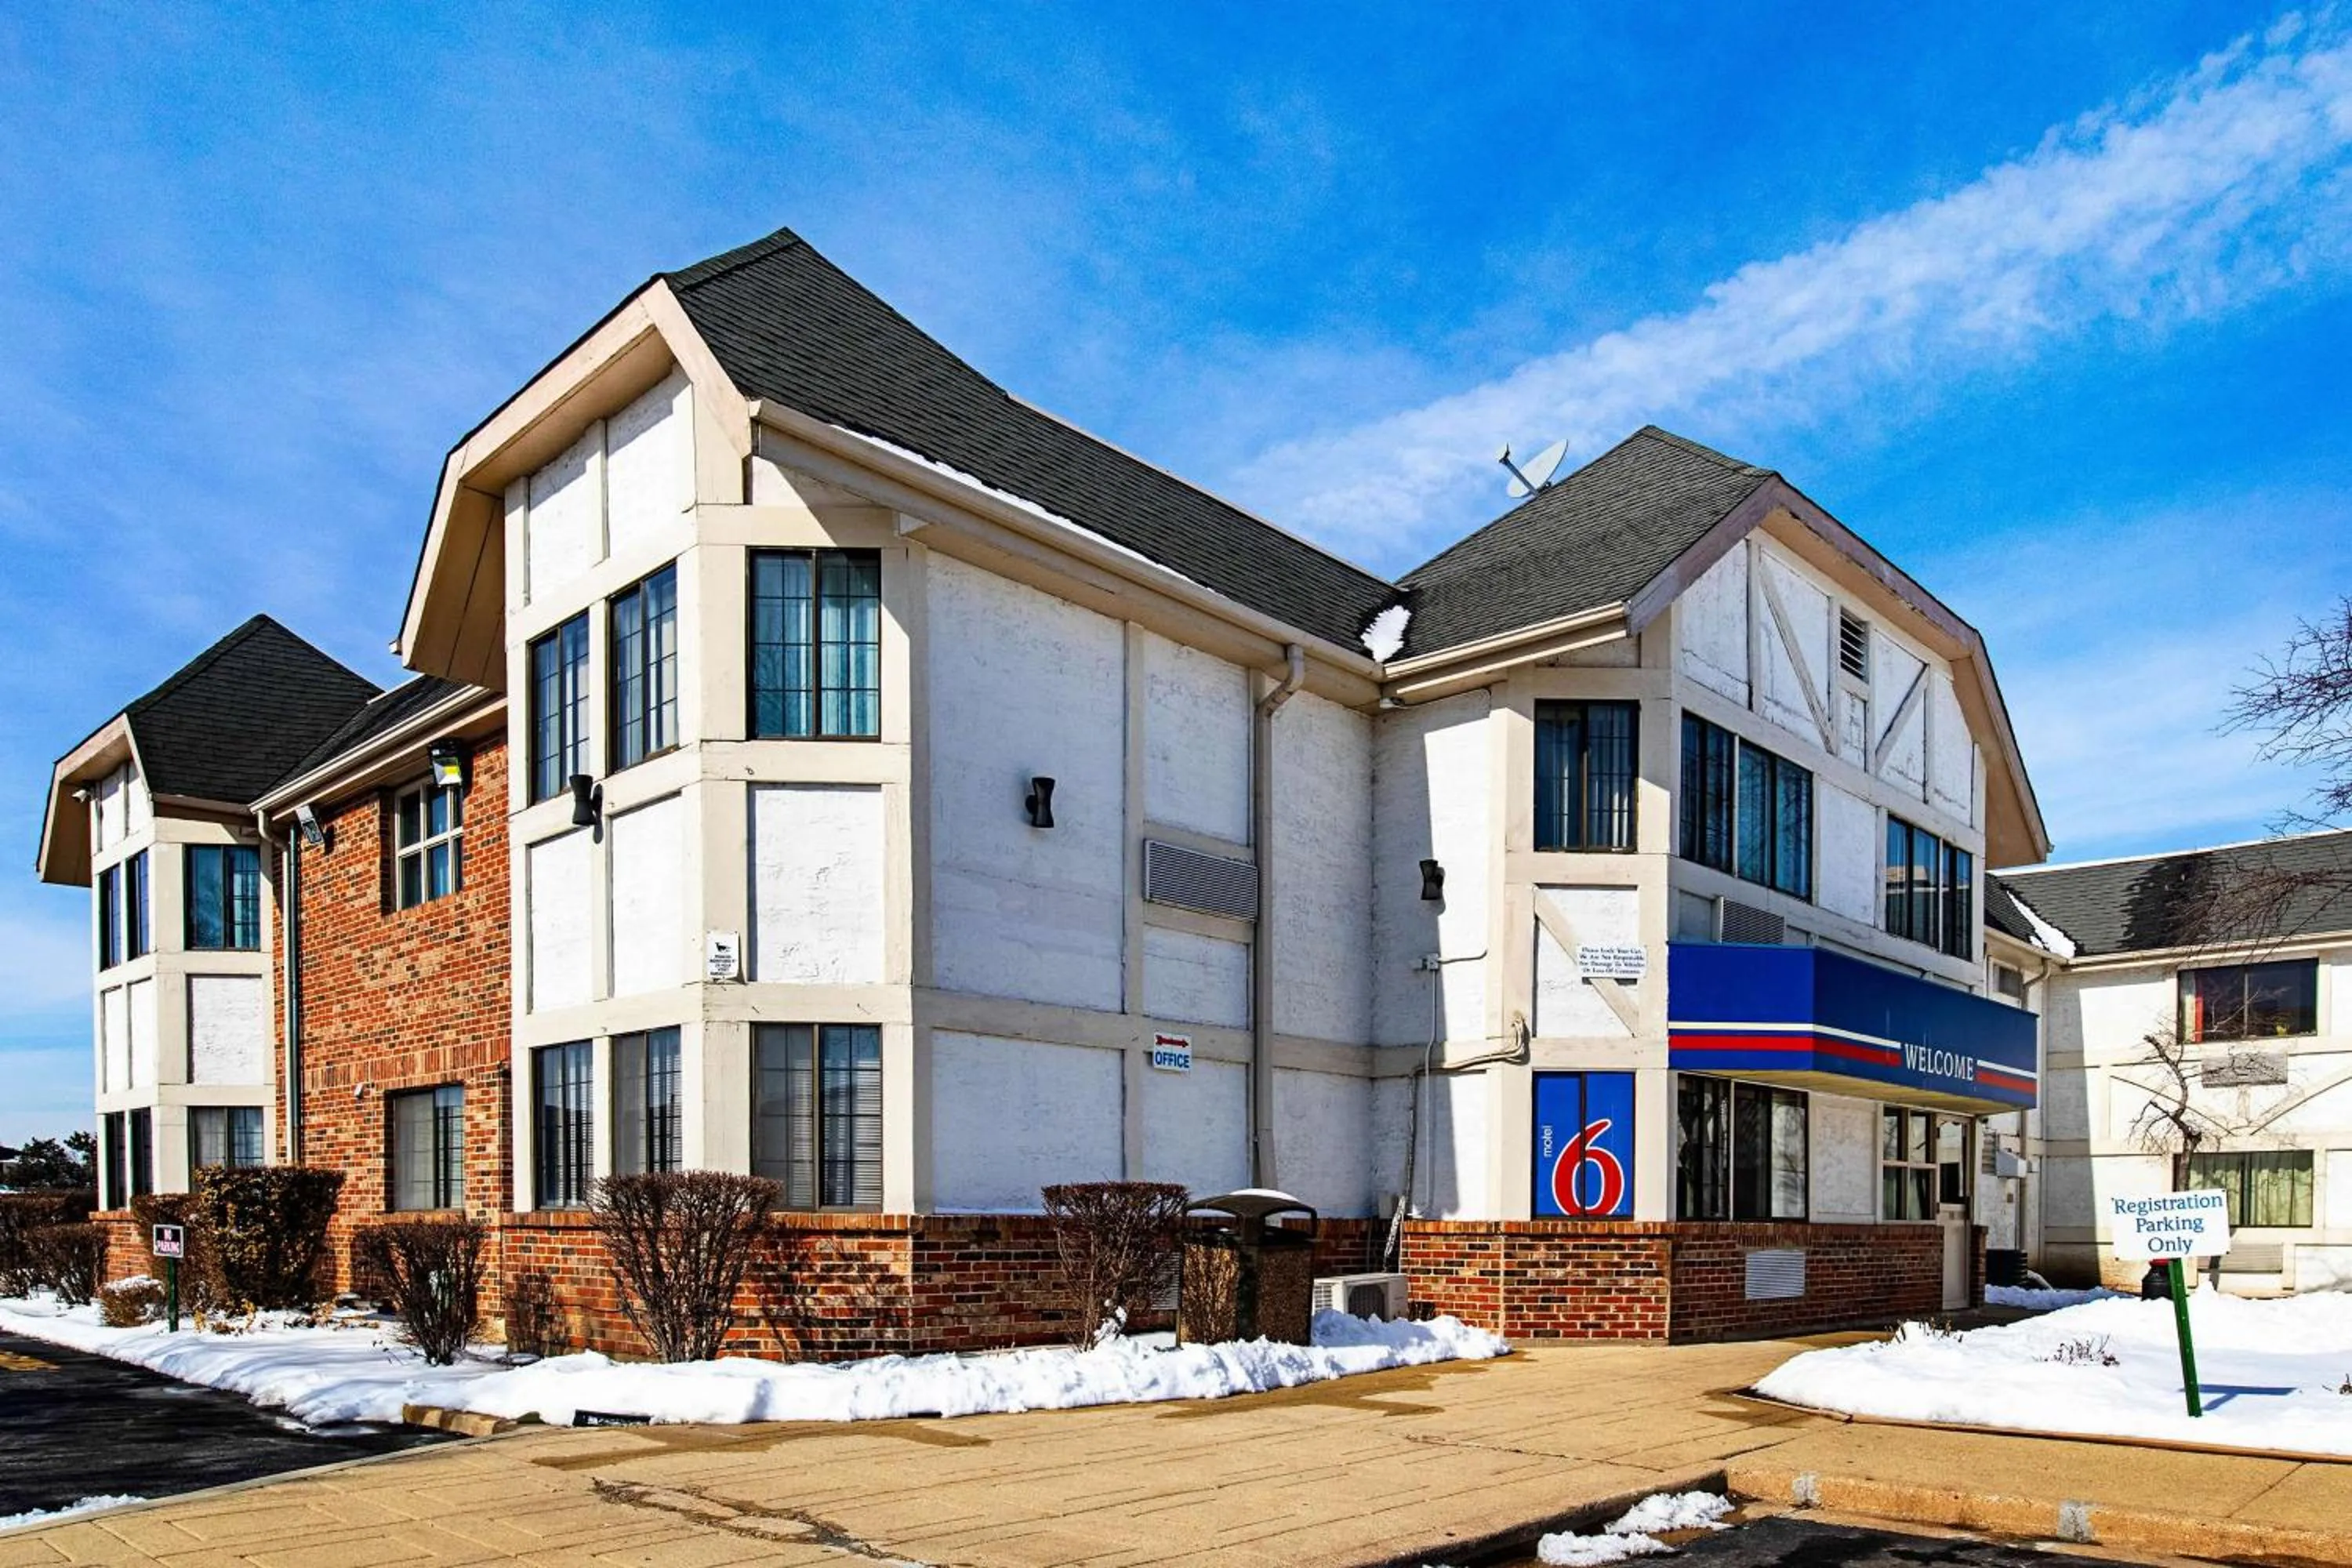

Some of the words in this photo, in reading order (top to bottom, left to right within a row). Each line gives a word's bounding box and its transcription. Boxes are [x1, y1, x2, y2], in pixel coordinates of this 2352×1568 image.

[1155, 1051, 1189, 1069] OFFICE
[1904, 1043, 1974, 1081] WELCOME
[1543, 1125, 1553, 1158] motel
[1552, 1119, 1625, 1216] 6
[2114, 1194, 2223, 1215] Registration
[164, 1229, 172, 1240] NO
[2136, 1217, 2205, 1233] Parking
[2147, 1236, 2194, 1254] Only
